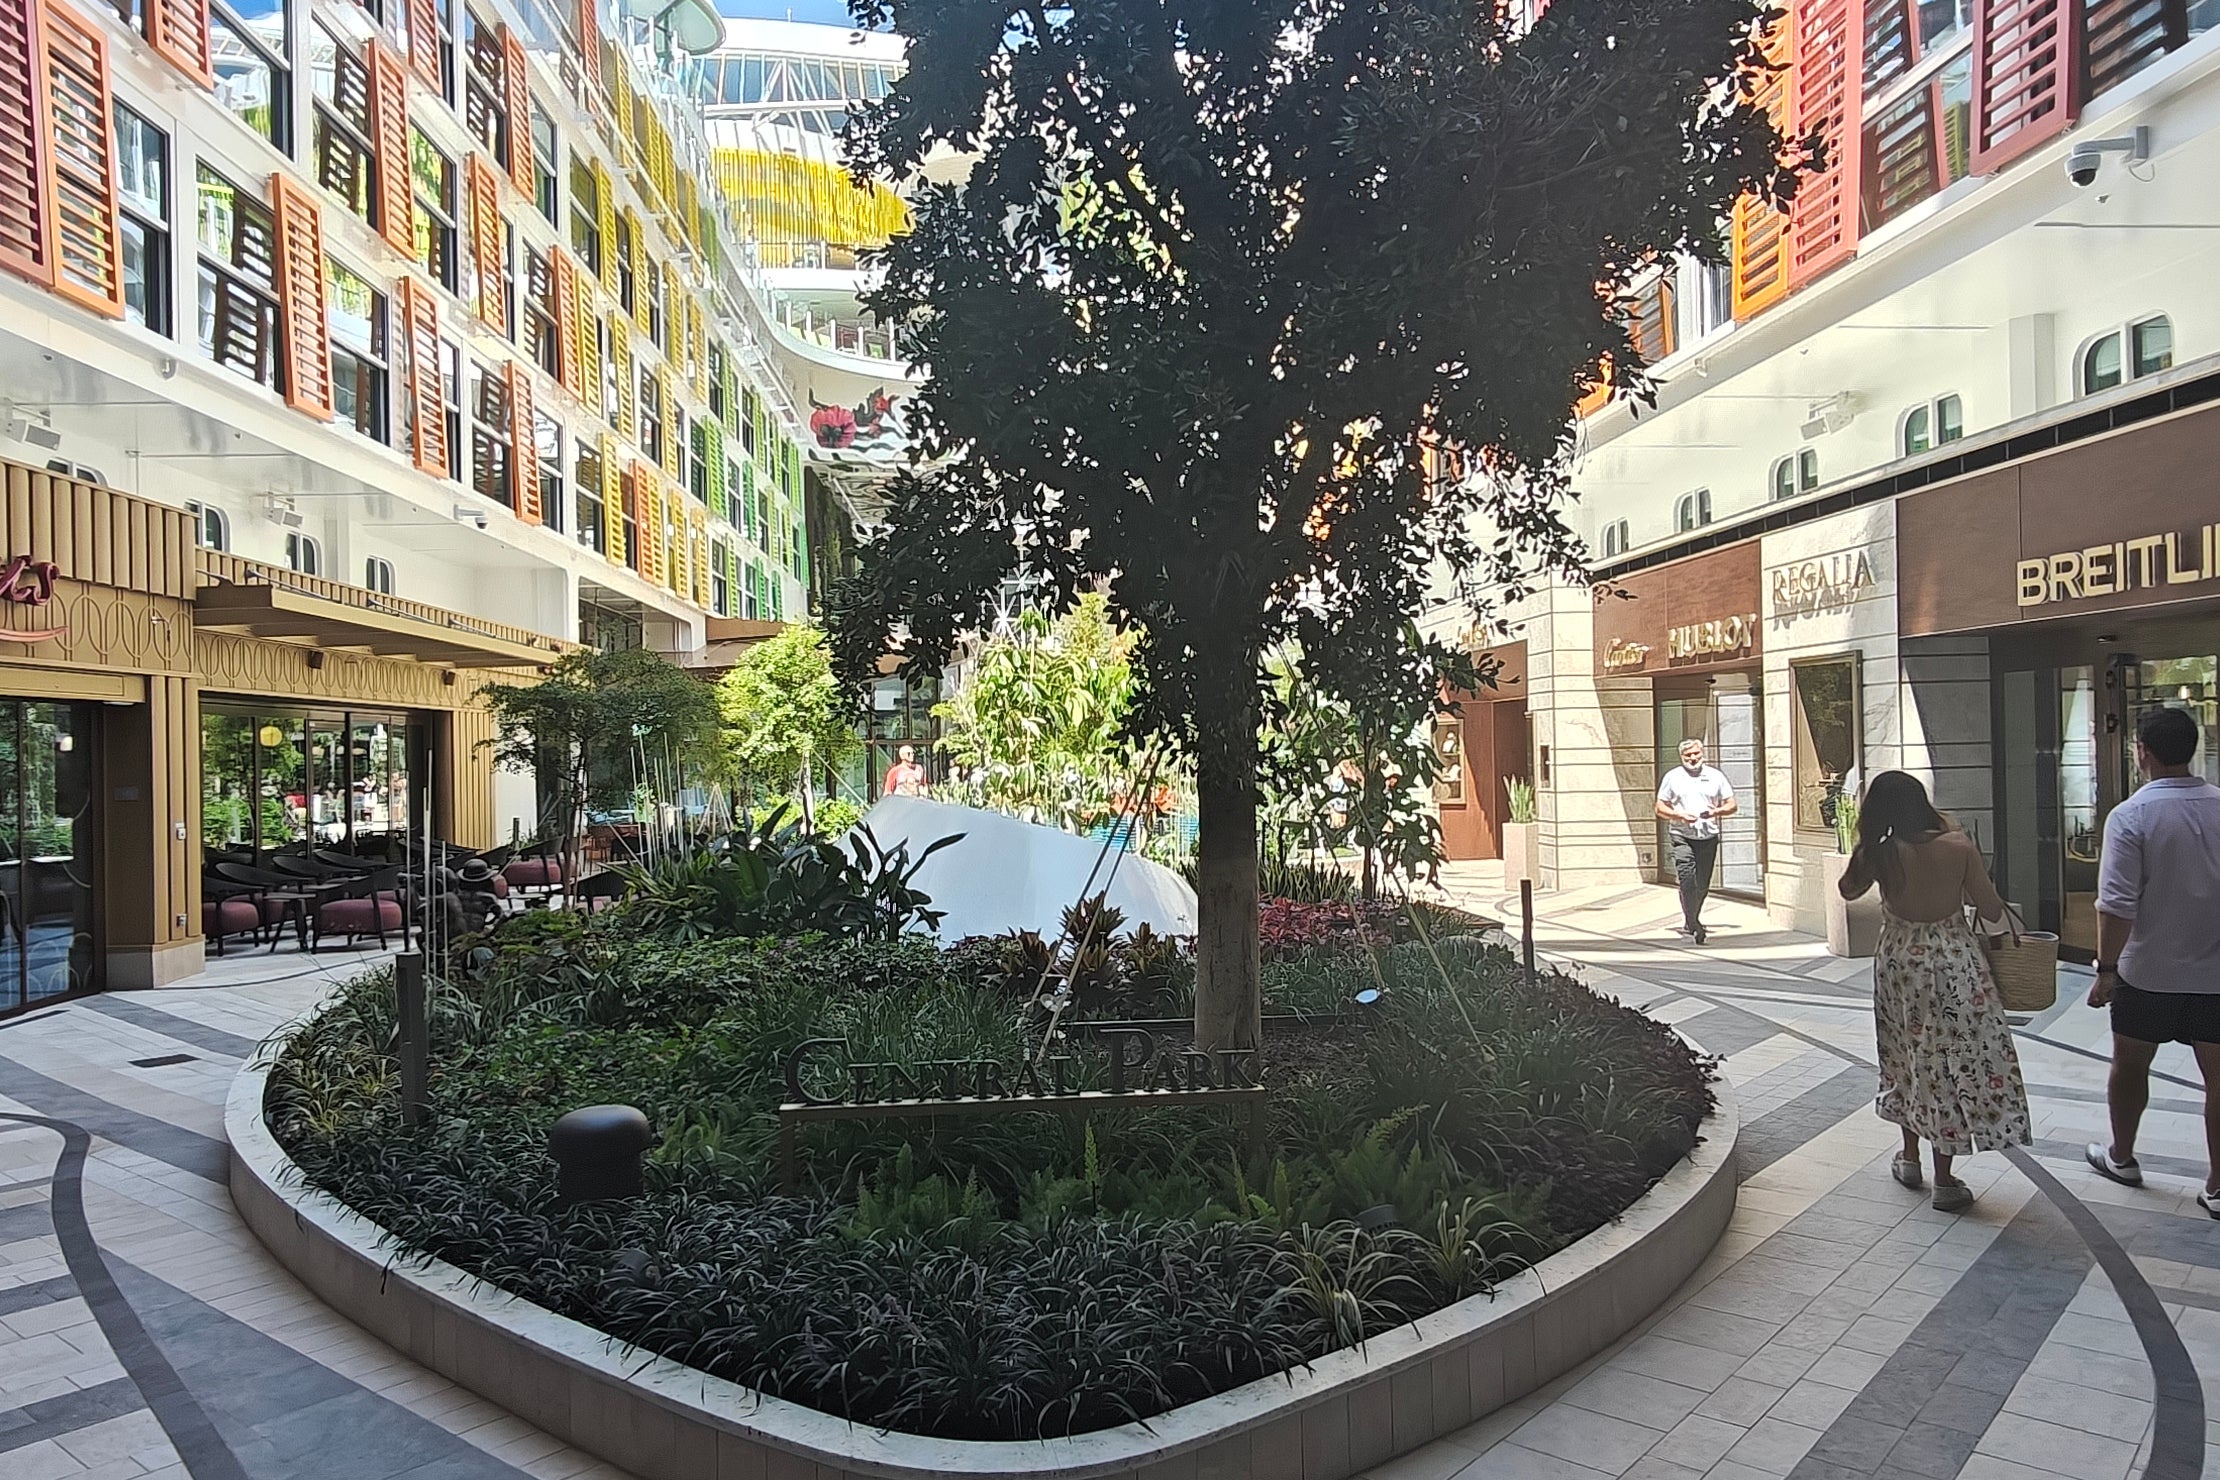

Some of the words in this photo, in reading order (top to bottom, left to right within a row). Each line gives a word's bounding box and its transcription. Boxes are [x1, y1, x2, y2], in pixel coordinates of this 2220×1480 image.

[1772, 550, 1876, 606] REGALIA
[2017, 523, 2220, 607] BREITLI
[1667, 613, 1757, 659] HUBLOT
[785, 1036, 1084, 1105] CENTRAL
[1098, 1027, 1264, 1094] PARK
